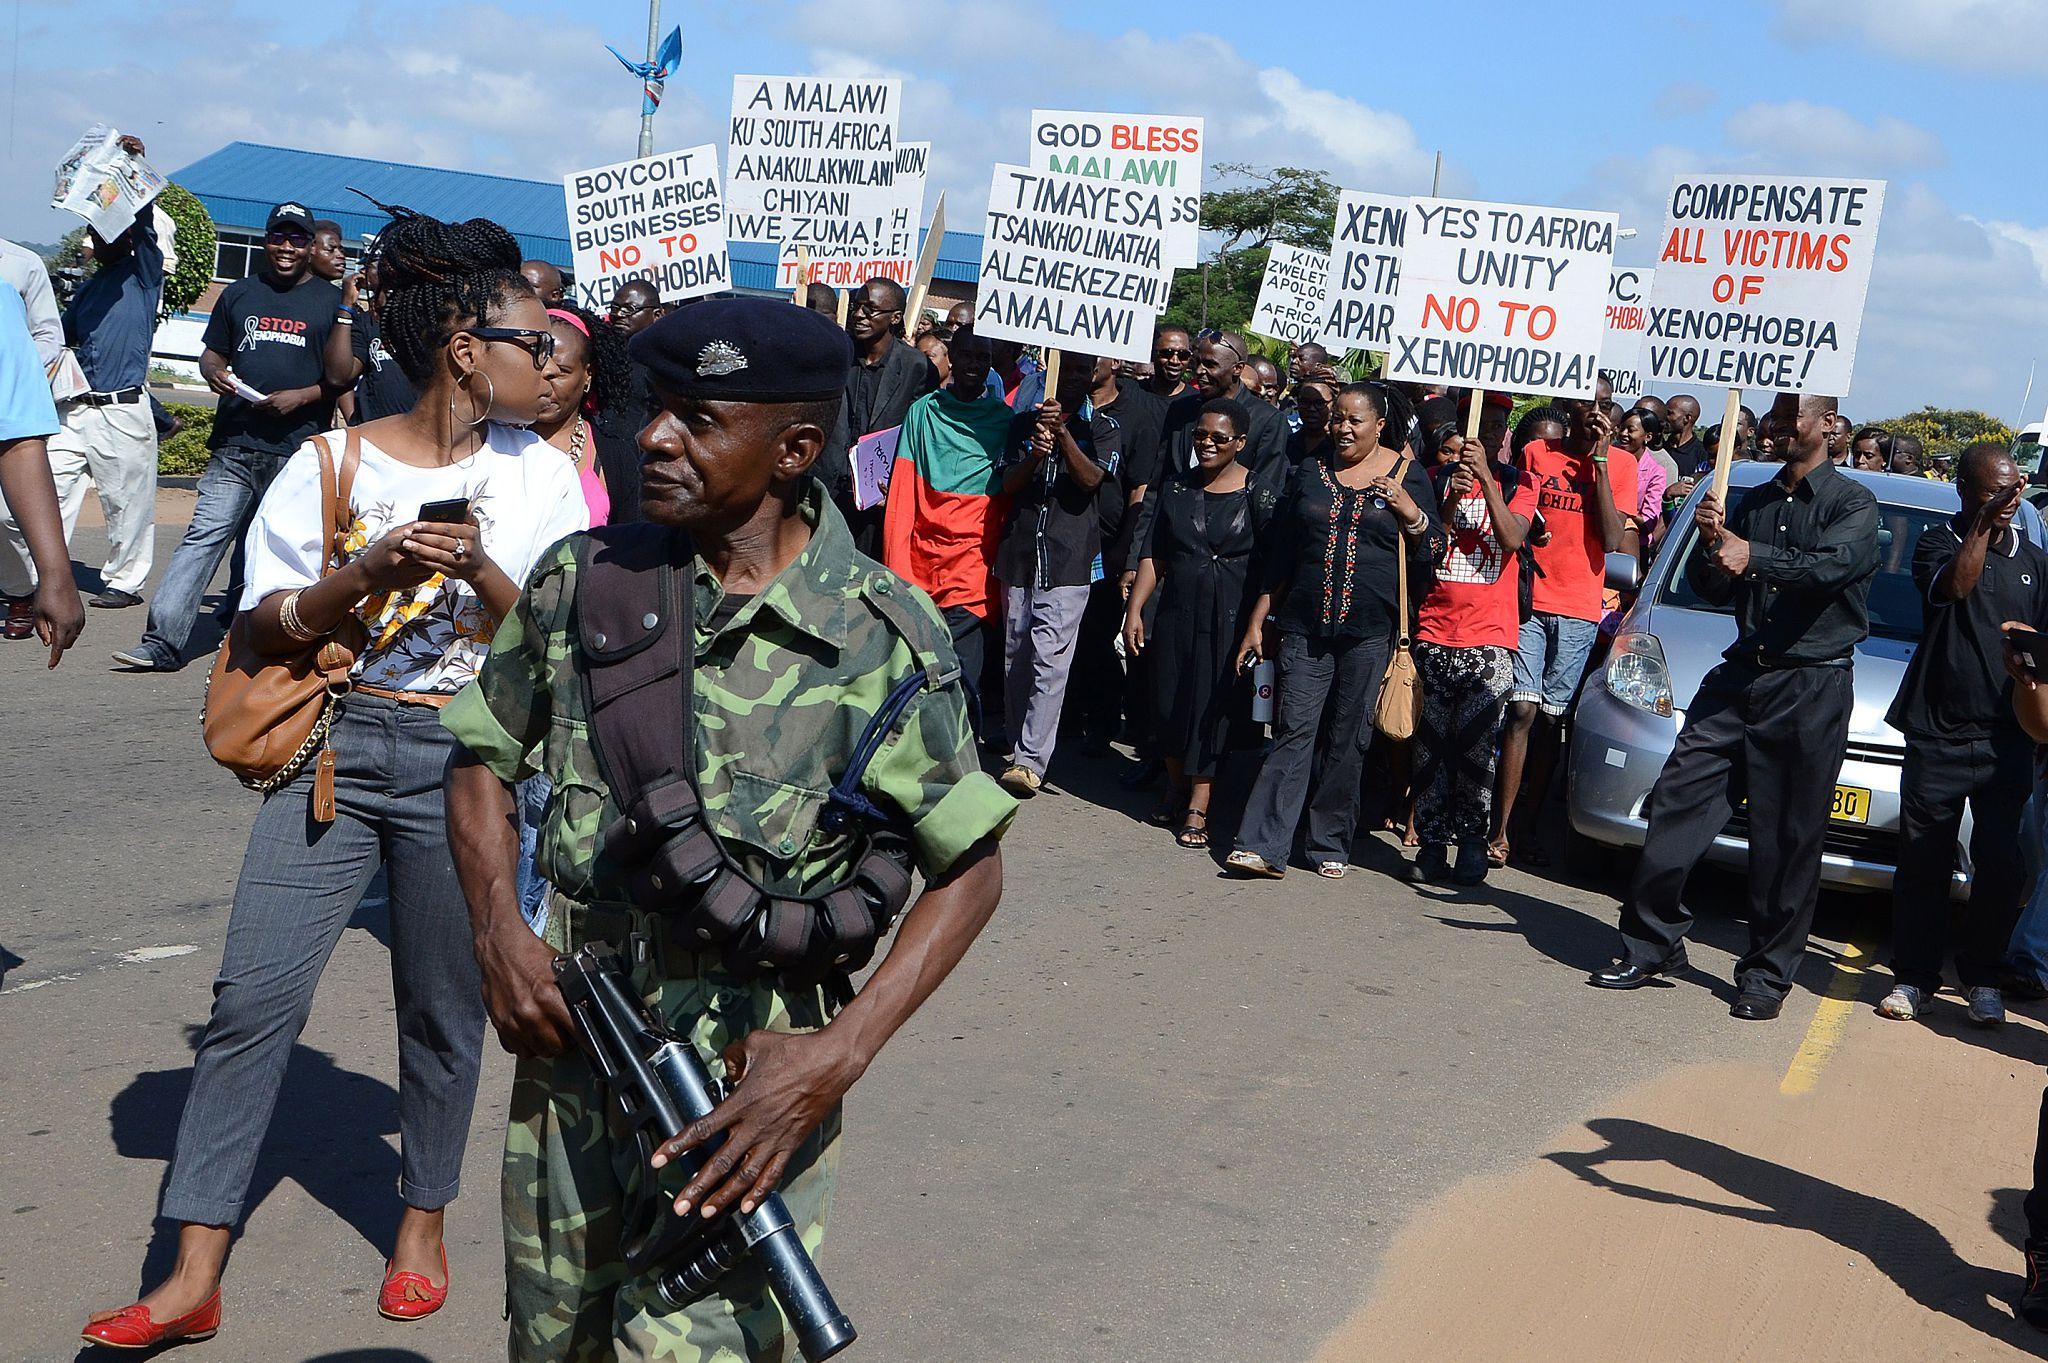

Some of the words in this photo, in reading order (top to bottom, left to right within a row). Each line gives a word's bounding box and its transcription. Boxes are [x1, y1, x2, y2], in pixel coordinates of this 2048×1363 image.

[747, 82, 773, 111] A
[784, 82, 888, 115] MALAWI
[731, 117, 755, 146] KU
[760, 118, 823, 151] SOUTH
[825, 121, 892, 152] AFRICA
[1037, 123, 1101, 147] GOD
[1111, 125, 1199, 153] BLESS
[577, 192, 646, 225] SOUTH
[651, 178, 718, 210] AFRICA
[763, 188, 850, 217] CHIYANI
[1010, 173, 1163, 230] TIMAYESA
[1672, 183, 1868, 226] COMPENSATE
[576, 204, 721, 251] BUSINESSES
[1416, 203, 1479, 239] YES
[1488, 211, 1524, 244] TO
[1524, 216, 1613, 255] AFRICA
[600, 246, 640, 273] NO
[659, 233, 698, 258] TO
[1458, 248, 1570, 292] UNITY
[1662, 228, 1707, 264] ALL
[1724, 229, 1851, 273] VICTIMS
[826, 261, 851, 285] FOR
[1268, 260, 1328, 287] ZWELET
[1342, 251, 1369, 290] IS
[1712, 274, 1765, 305] OF
[1261, 303, 1321, 326] AFRICA
[1294, 297, 1315, 311] TO
[1421, 294, 1480, 333] NO
[1499, 300, 1557, 342] TO
[259, 317, 307, 333] STOP
[1270, 318, 1319, 343] NOW
[1646, 306, 1839, 351] XENOPHOBIA
[1393, 335, 1596, 391] XENOPHOBIA!
[1650, 345, 1816, 389] VIOLENCE!
